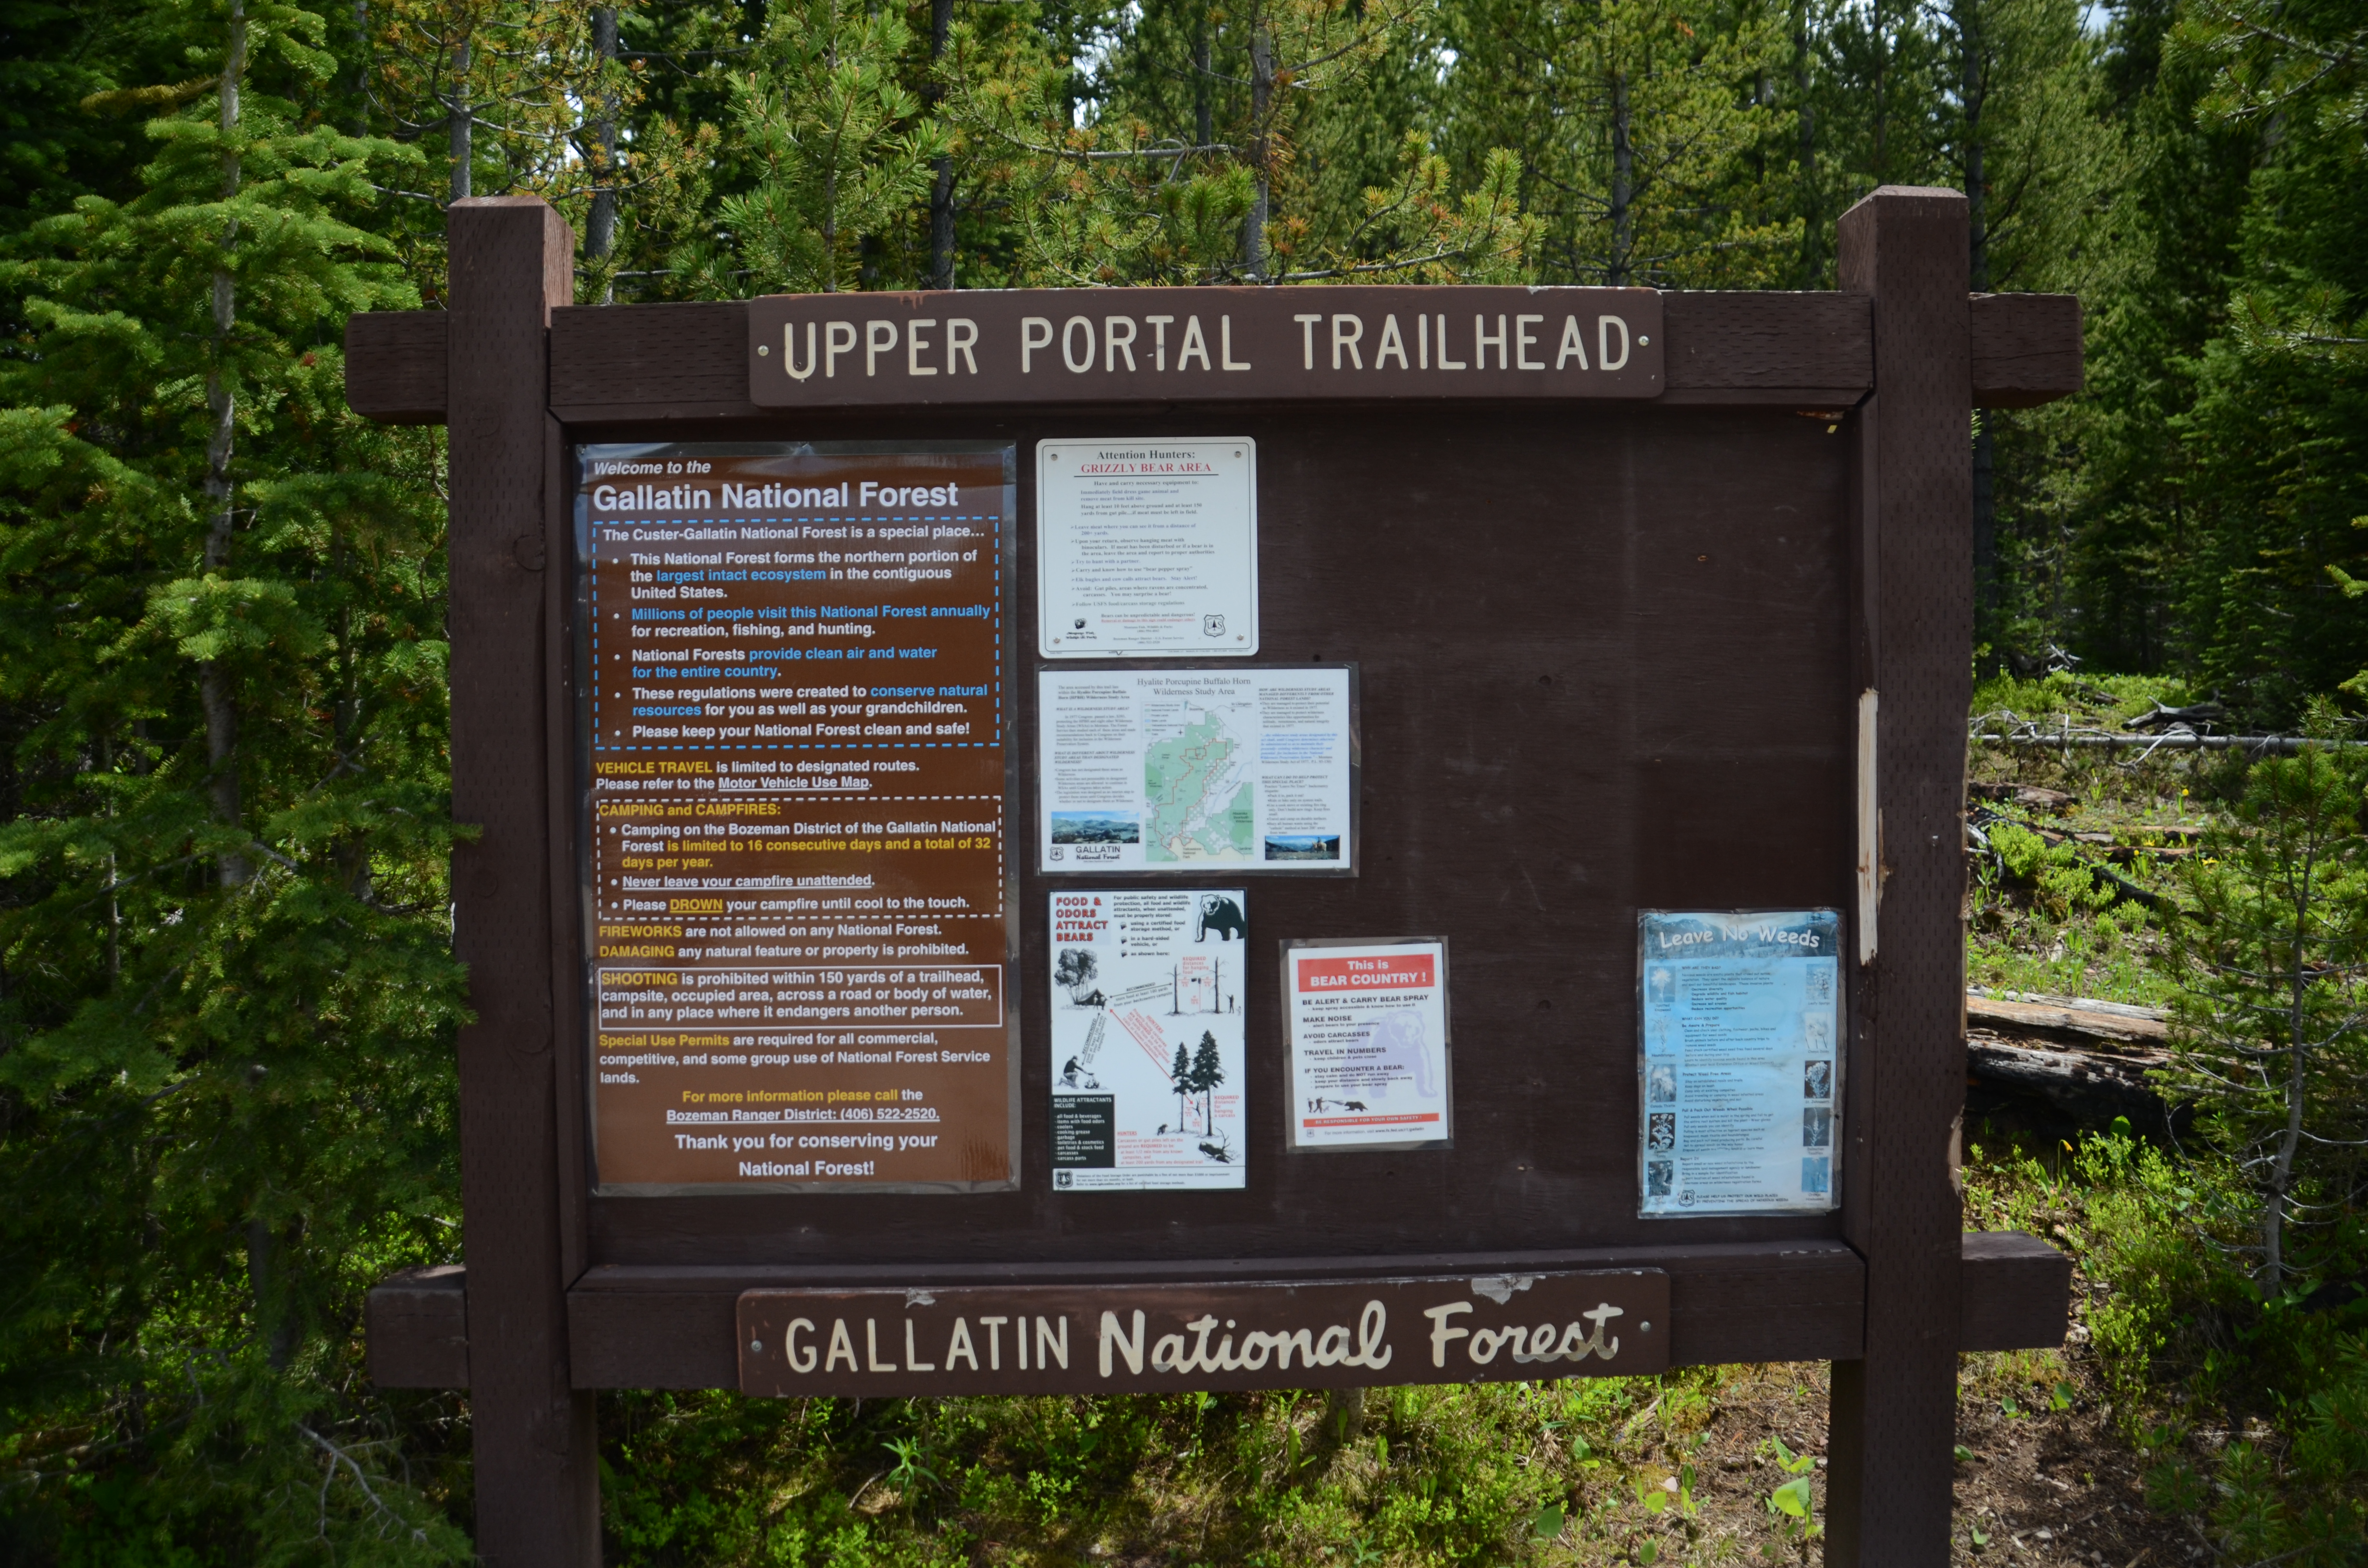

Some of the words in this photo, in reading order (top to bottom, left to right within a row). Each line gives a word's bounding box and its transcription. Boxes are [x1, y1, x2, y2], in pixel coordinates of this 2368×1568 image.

[784, 318, 978, 382] UPPER
[1021, 315, 1251, 373] PORTAL
[1294, 314, 1629, 370] TRAILHEAD
[1097, 451, 1145, 459] Attention
[1150, 450, 1195, 458] Hunters:
[594, 462, 663, 474] Welcome
[667, 461, 682, 474] to
[686, 460, 711, 473] the
[1081, 464, 1136, 472] GRIZZLY
[1141, 464, 1173, 472] BEAR
[1178, 463, 1211, 471] AREA
[593, 484, 711, 511] Gallatin
[721, 482, 848, 508] National
[860, 482, 958, 507] Forest
[602, 529, 629, 540] The
[632, 527, 737, 541] Custer-Gallatin
[740, 527, 798, 539] National
[802, 527, 848, 538] Forest
[851, 526, 863, 538] is
[866, 528, 875, 538] a
[879, 525, 928, 540] special
[629, 553, 660, 565] This
[664, 552, 722, 564] National
[726, 552, 771, 564] Forest
[774, 551, 815, 564] forms
[818, 551, 840, 563] the
[844, 551, 904, 563] northern
[908, 550, 959, 564] portion
[962, 549, 977, 562] of
[630, 570, 653, 582] the
[656, 570, 704, 584] largest
[708, 569, 747, 580] intact
[751, 569, 826, 583] ecosystem
[830, 567, 843, 579] in
[846, 567, 869, 579] the
[872, 567, 952, 581] contiguous
[631, 587, 676, 599] United
[680, 586, 728, 598] States.
[1137, 678, 1163, 686] Hyalite
[1165, 678, 1201, 686] Porcupine
[596, 762, 654, 773] VEHICLE
[658, 762, 713, 773] TRAVEL
[716, 761, 728, 772] is
[732, 761, 776, 772] limited
[779, 761, 793, 772] to
[796, 760, 870, 774] designated
[873, 760, 920, 772] routes.
[598, 803, 664, 816] CAMPING
[667, 803, 692, 816] and
[695, 803, 781, 815] CAMPFIRES:
[623, 899, 666, 910] Please
[670, 899, 723, 911] DROWN
[726, 901, 757, 913] your
[760, 898, 818, 912] campfire
[822, 897, 851, 909] until
[854, 897, 883, 909] cool
[886, 898, 900, 909] to
[903, 897, 925, 908] the
[927, 896, 970, 908] touch.
[1056, 897, 1088, 906] FOOD
[1056, 909, 1096, 918] ODORS
[599, 926, 682, 937] FIREWORKS
[685, 928, 706, 937] are
[710, 926, 732, 937] not
[735, 925, 786, 937] allowed
[789, 927, 806, 936] on
[810, 927, 835, 939] any
[838, 924, 892, 935] National
[895, 924, 942, 935] Forest.
[1056, 920, 1108, 930] ATTRACT
[1057, 932, 1093, 942] BEARS
[1660, 930, 1714, 949] Leave
[1723, 925, 1749, 942] No
[1759, 926, 1820, 948] Weeds
[1347, 960, 1374, 970] This
[1378, 960, 1389, 968] is
[1311, 975, 1347, 986] BEAR
[1351, 972, 1418, 985] COUNTRY
[682, 1091, 705, 1102] For
[709, 1093, 743, 1102] more
[747, 1090, 824, 1102] information
[827, 1090, 871, 1103] please
[874, 1089, 898, 1101] call
[901, 1089, 923, 1100] the
[666, 1110, 728, 1122] Bozeman
[732, 1110, 781, 1124] Ranger
[784, 1108, 836, 1121] District:
[840, 1108, 873, 1123] (406)
[876, 1108, 939, 1121] 522-2520.
[674, 1134, 728, 1149] Thank
[732, 1137, 764, 1152] you
[769, 1133, 794, 1148] for
[798, 1133, 893, 1151] conserving
[898, 1136, 938, 1151] your
[739, 1161, 809, 1176] National
[815, 1161, 874, 1175] Forest!
[786, 1316, 1068, 1373] GALLATIN
[1099, 1300, 1392, 1374] National
[1424, 1301, 1623, 1367] Forest
